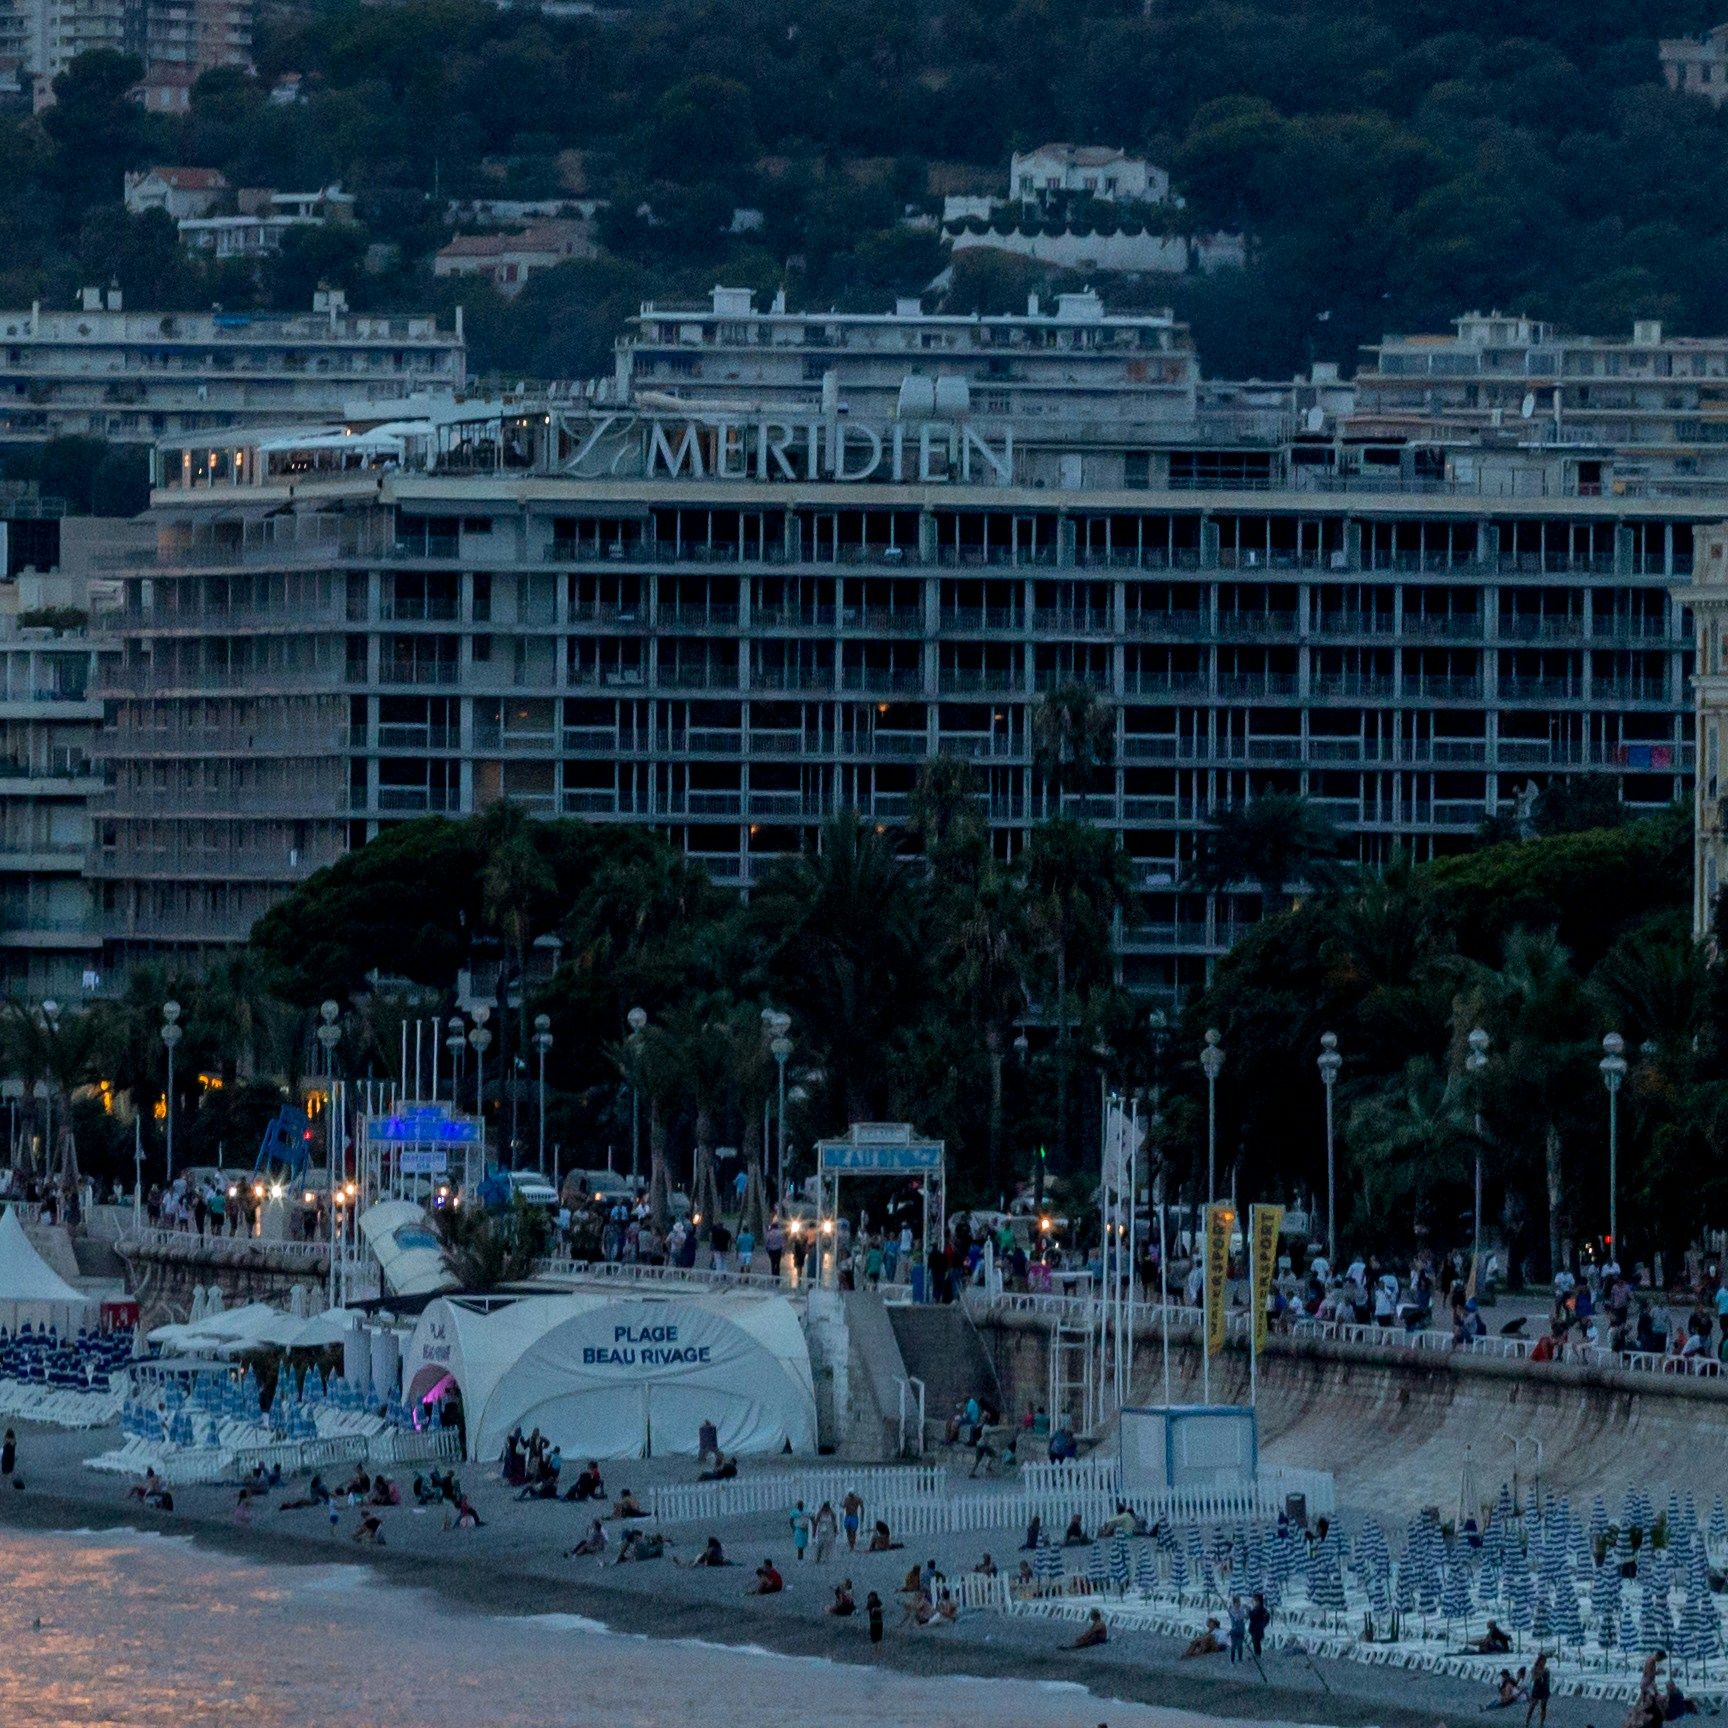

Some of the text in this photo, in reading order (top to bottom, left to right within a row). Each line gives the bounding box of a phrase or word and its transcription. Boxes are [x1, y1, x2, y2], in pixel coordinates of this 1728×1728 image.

[646, 421, 1014, 486] MERIDIEN
[614, 1325, 678, 1342] PLAGE
[583, 1346, 711, 1365] BEAU RIVAGE
